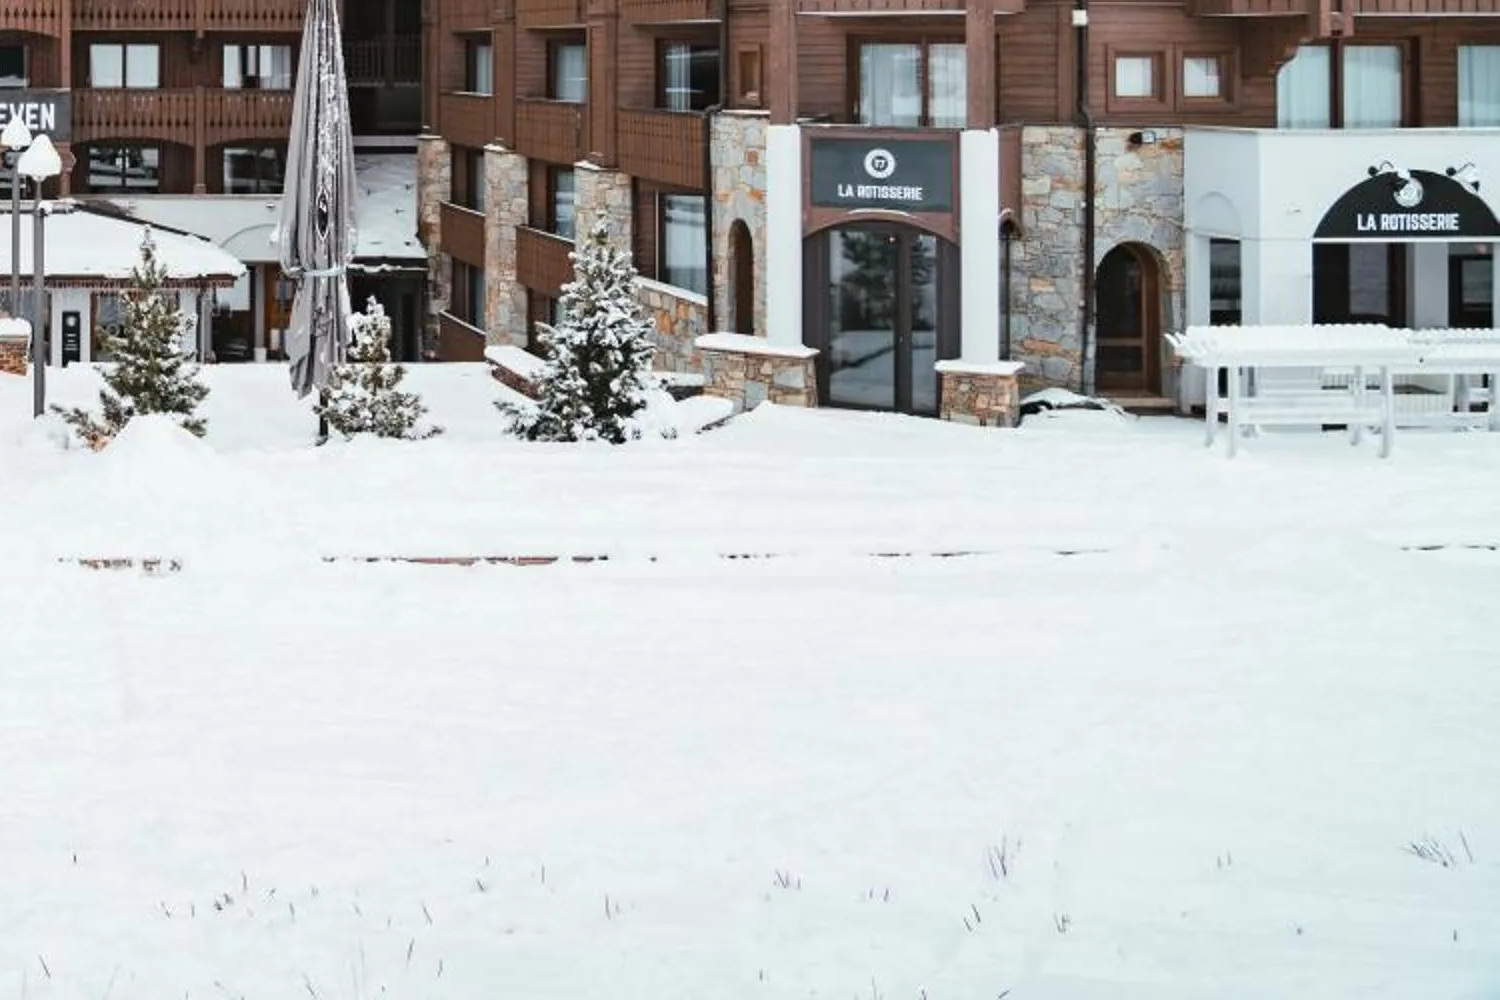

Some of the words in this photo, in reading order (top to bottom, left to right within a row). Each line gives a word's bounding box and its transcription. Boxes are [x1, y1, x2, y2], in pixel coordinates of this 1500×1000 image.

[837, 183, 854, 198] LA
[857, 184, 923, 201] ROTISSERIE
[1357, 213, 1377, 231] LA
[1380, 213, 1460, 231] ROTISSERIE
